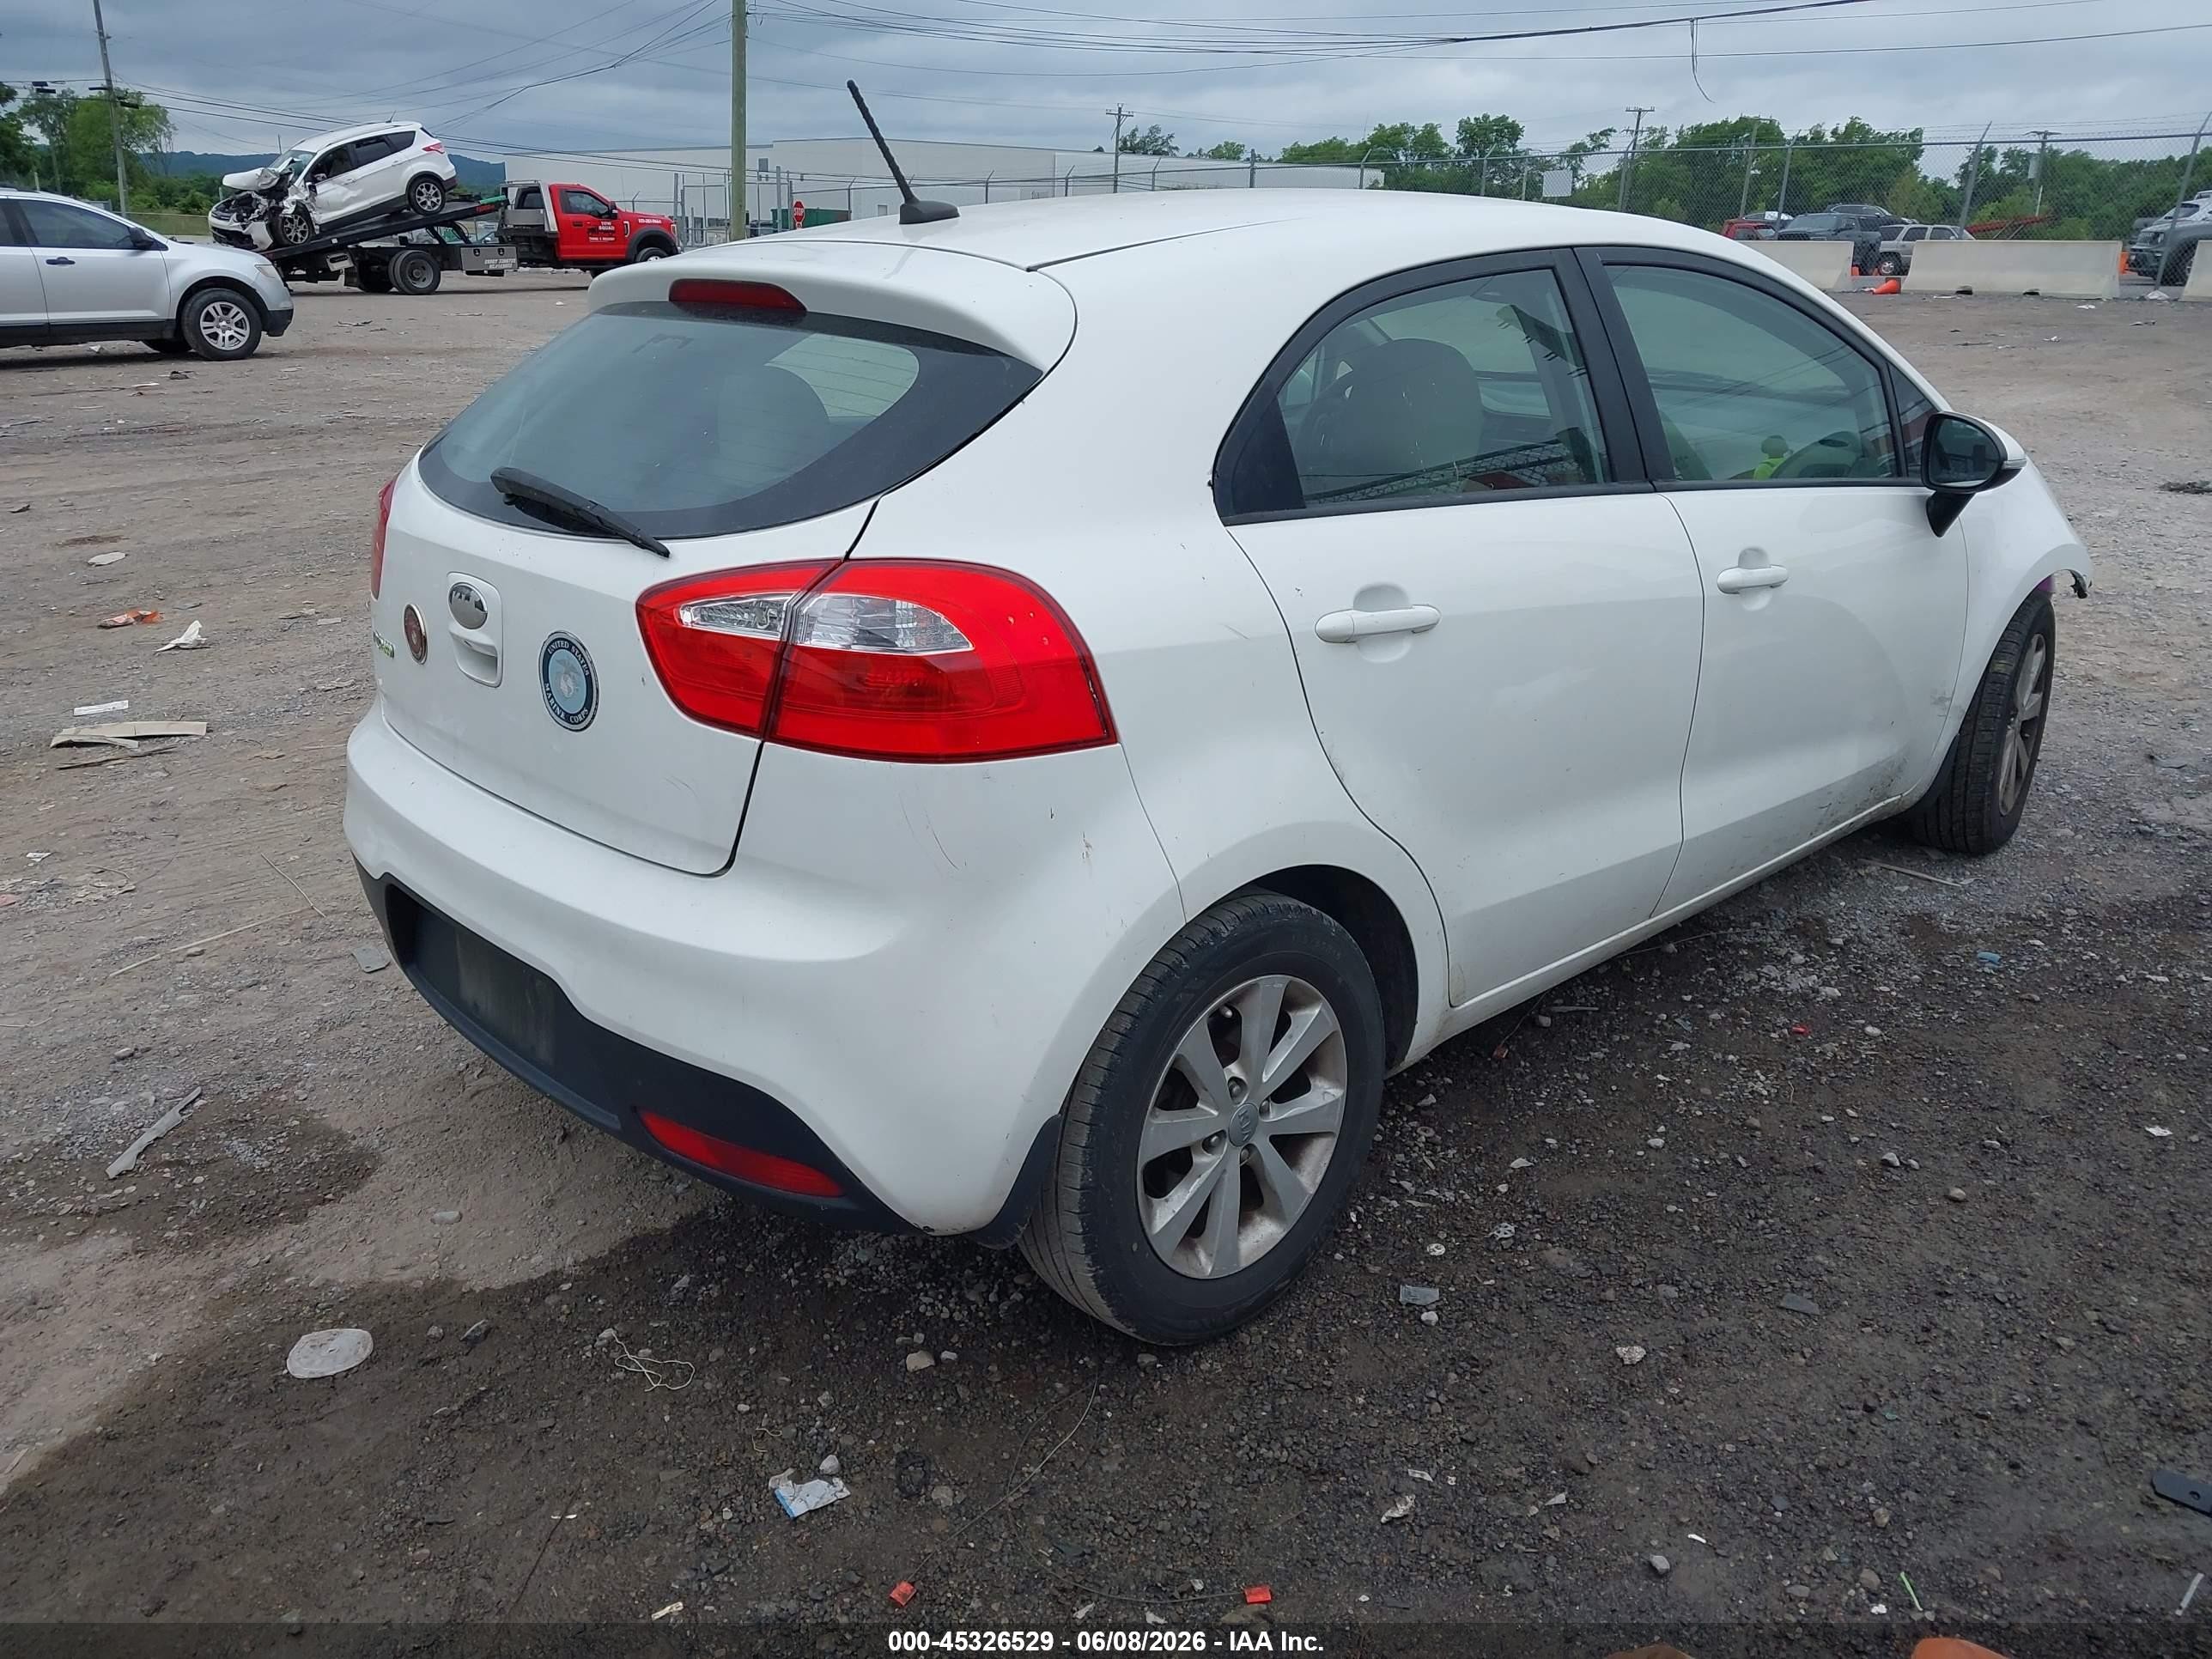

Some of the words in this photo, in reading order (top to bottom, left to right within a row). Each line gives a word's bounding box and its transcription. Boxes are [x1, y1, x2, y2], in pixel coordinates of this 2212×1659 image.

[793, 207, 804, 216] STOP
[547, 640, 569, 654] UNITED
[570, 645, 590, 677] STATES
[544, 682, 566, 720] MARINE
[569, 707, 589, 724] CORPS
